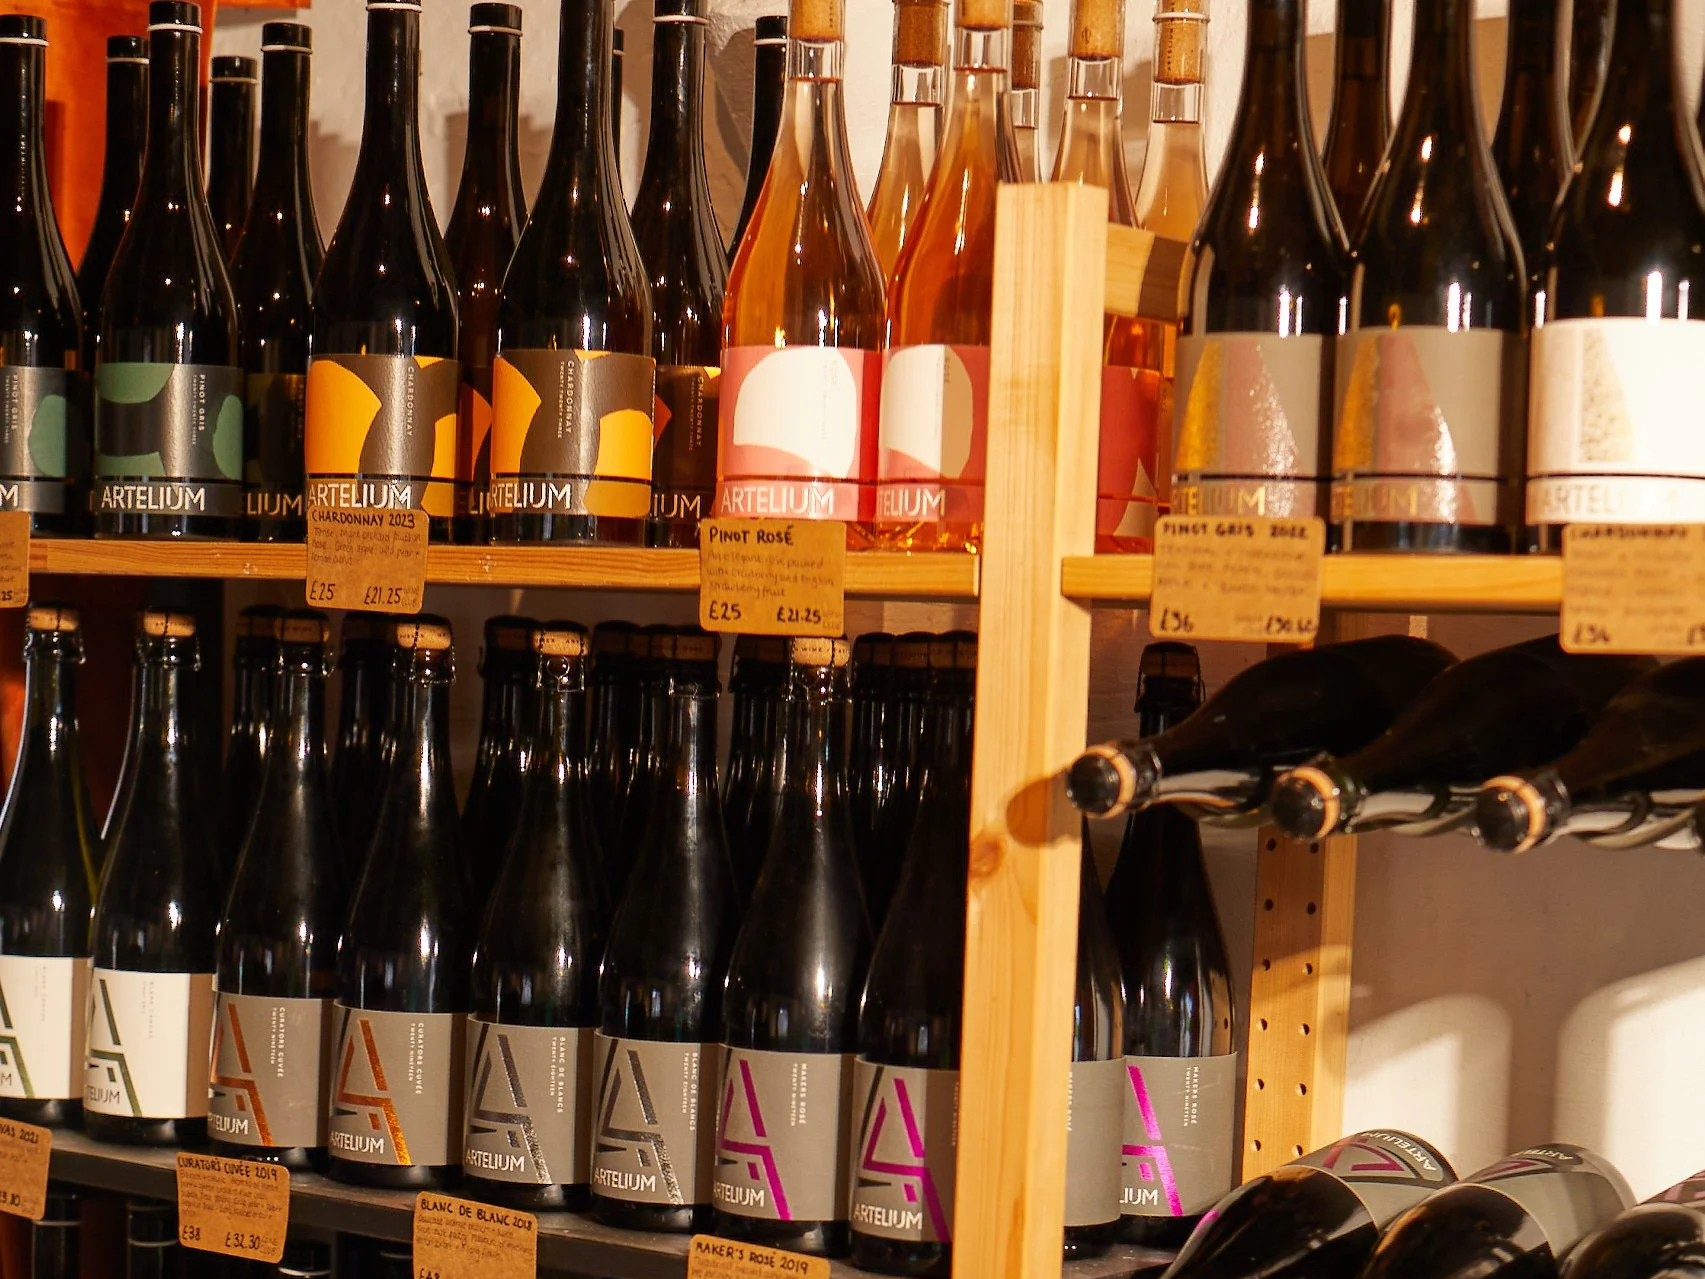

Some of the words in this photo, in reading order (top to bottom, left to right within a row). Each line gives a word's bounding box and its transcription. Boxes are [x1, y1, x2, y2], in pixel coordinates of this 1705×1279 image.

[198, 374, 206, 404] PINOT
[406, 366, 415, 437] CHARDONNAY
[565, 360, 575, 434] CHARDONNAY
[197, 407, 206, 432] GRIS
[697, 376, 705, 447] CHARDONNAY
[101, 485, 206, 511] ARTELIUM
[308, 483, 412, 510] ARTELIUM
[720, 486, 835, 516] ARTELIUM
[311, 509, 384, 526] CHARDONNAY
[388, 513, 415, 529] 2023
[1163, 523, 1208, 537] PINOT
[1215, 523, 1255, 538] GRIS
[709, 526, 750, 544] PINOT
[756, 524, 795, 546] ROSÉ
[310, 580, 336, 601] £25
[363, 586, 403, 606] £21.25
[709, 600, 742, 621] £25
[776, 606, 822, 624] £21.25
[278, 1006, 286, 1049] CURATORS
[417, 1022, 425, 1065] CURATORS
[415, 1068, 423, 1095] CUVÉE
[559, 1067, 566, 1079] DE
[557, 1081, 565, 1114] BLANCS
[691, 1083, 697, 1095] DE
[798, 1103, 806, 1125] ROSÉ
[1190, 1102, 1198, 1125] ROSÉ
[329, 1131, 385, 1155] ARTELIUM
[178, 1157, 221, 1172] CURATOR'S
[224, 1160, 251, 1178] CUVÉE
[255, 1166, 278, 1182] 2019
[465, 1149, 525, 1173] ARTELIUM
[594, 1167, 656, 1193] ARTELIUM
[421, 1199, 453, 1214] BLANC
[459, 1205, 472, 1218] DE
[477, 1209, 510, 1226] BLANC
[512, 1216, 533, 1231] 2018
[853, 1203, 923, 1231] ARTELIUM
[182, 1225, 201, 1241] £38
[225, 1232, 260, 1251] £32.30
[696, 1242, 744, 1261] MAKER'S
[749, 1251, 776, 1268] ROSÉ
[780, 1256, 809, 1275] 2019
